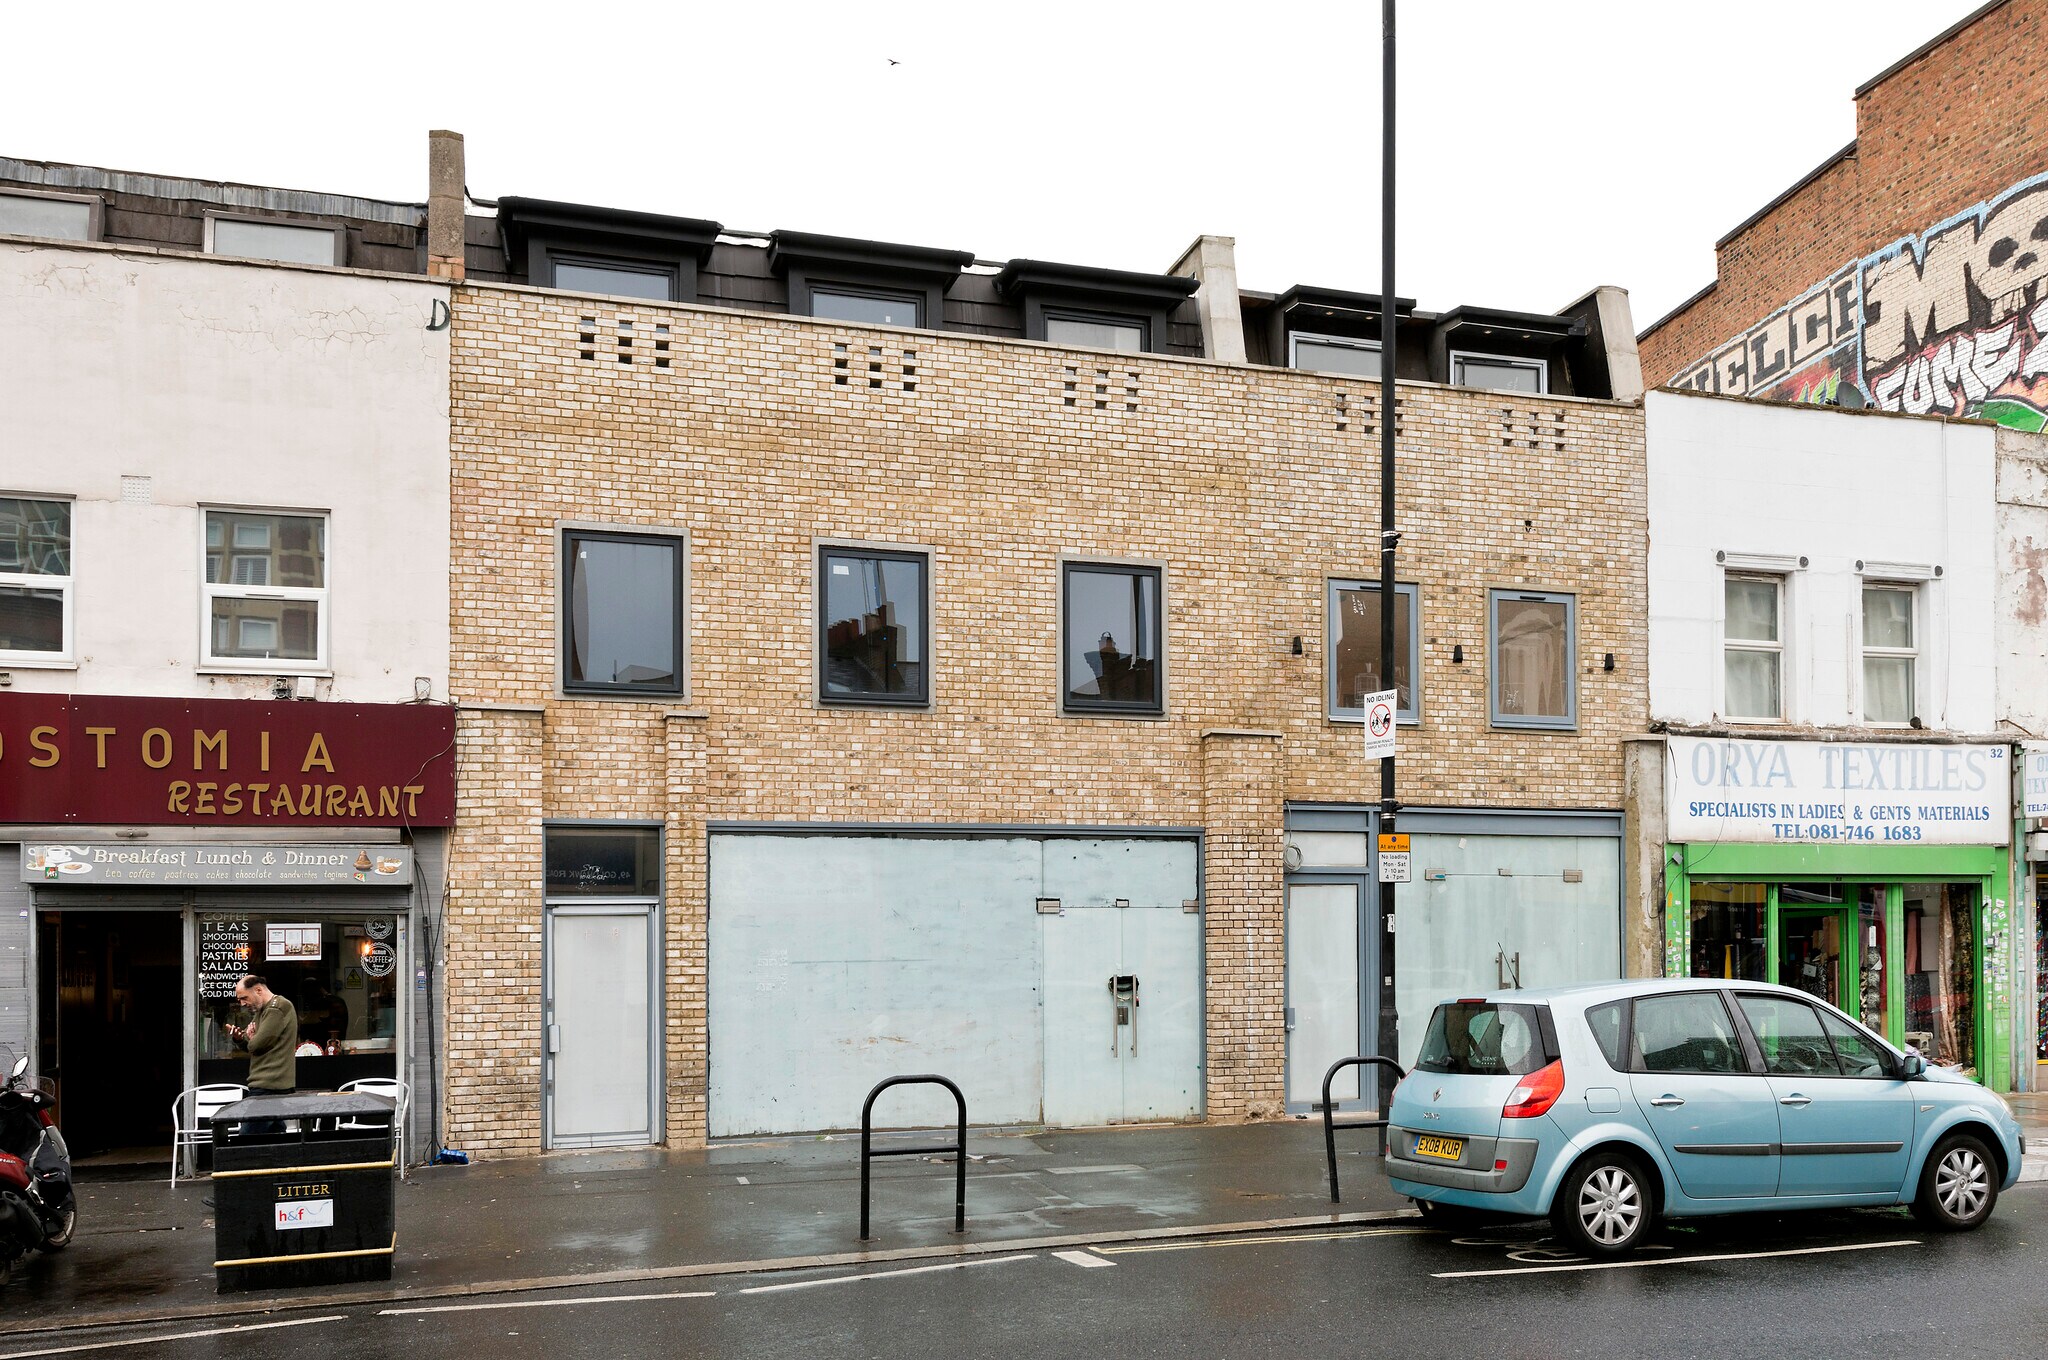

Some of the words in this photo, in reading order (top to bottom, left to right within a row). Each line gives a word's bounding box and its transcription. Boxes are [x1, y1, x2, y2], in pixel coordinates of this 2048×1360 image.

[1376, 693, 1395, 702] IDLING
[0, 726, 334, 773] STOMIA
[1990, 748, 2003, 758] 32
[1692, 742, 1797, 788] ORYA
[1818, 745, 1987, 791] TEXTILES
[168, 780, 425, 817] RESTAURANT
[1689, 801, 1777, 818] SPECIALISTS
[1781, 804, 1794, 819] IN
[1799, 804, 1845, 819] LADIES
[1853, 805, 1863, 820] &
[1870, 805, 1911, 821] GENTS
[1918, 806, 1990, 821] MATERIALS
[1883, 825, 1922, 841] 1683
[93, 849, 188, 866] Breakfast
[195, 850, 252, 865] Lunch
[261, 851, 276, 866] &
[284, 851, 348, 866] Dinner
[105, 868, 122, 878] tea
[128, 867, 155, 880] coffee
[164, 868, 199, 881] pastries
[206, 868, 228, 879] cakes
[235, 869, 272, 879] chocolate
[279, 870, 318, 880] sandwiches
[203, 912, 249, 920] COFFEE
[203, 922, 249, 931] TEAS
[202, 932, 249, 941] SMOOTHIES
[202, 942, 249, 950] CHOCOLATE
[202, 951, 249, 960] PASTRIES
[202, 961, 249, 971] SALADS
[216, 981, 237, 989] CREA
[202, 990, 222, 998] COLD
[1418, 1137, 1441, 1153] EX08
[1440, 1140, 1460, 1156] KUR
[277, 1184, 331, 1198] LITTER
[279, 1208, 305, 1222] h&f
